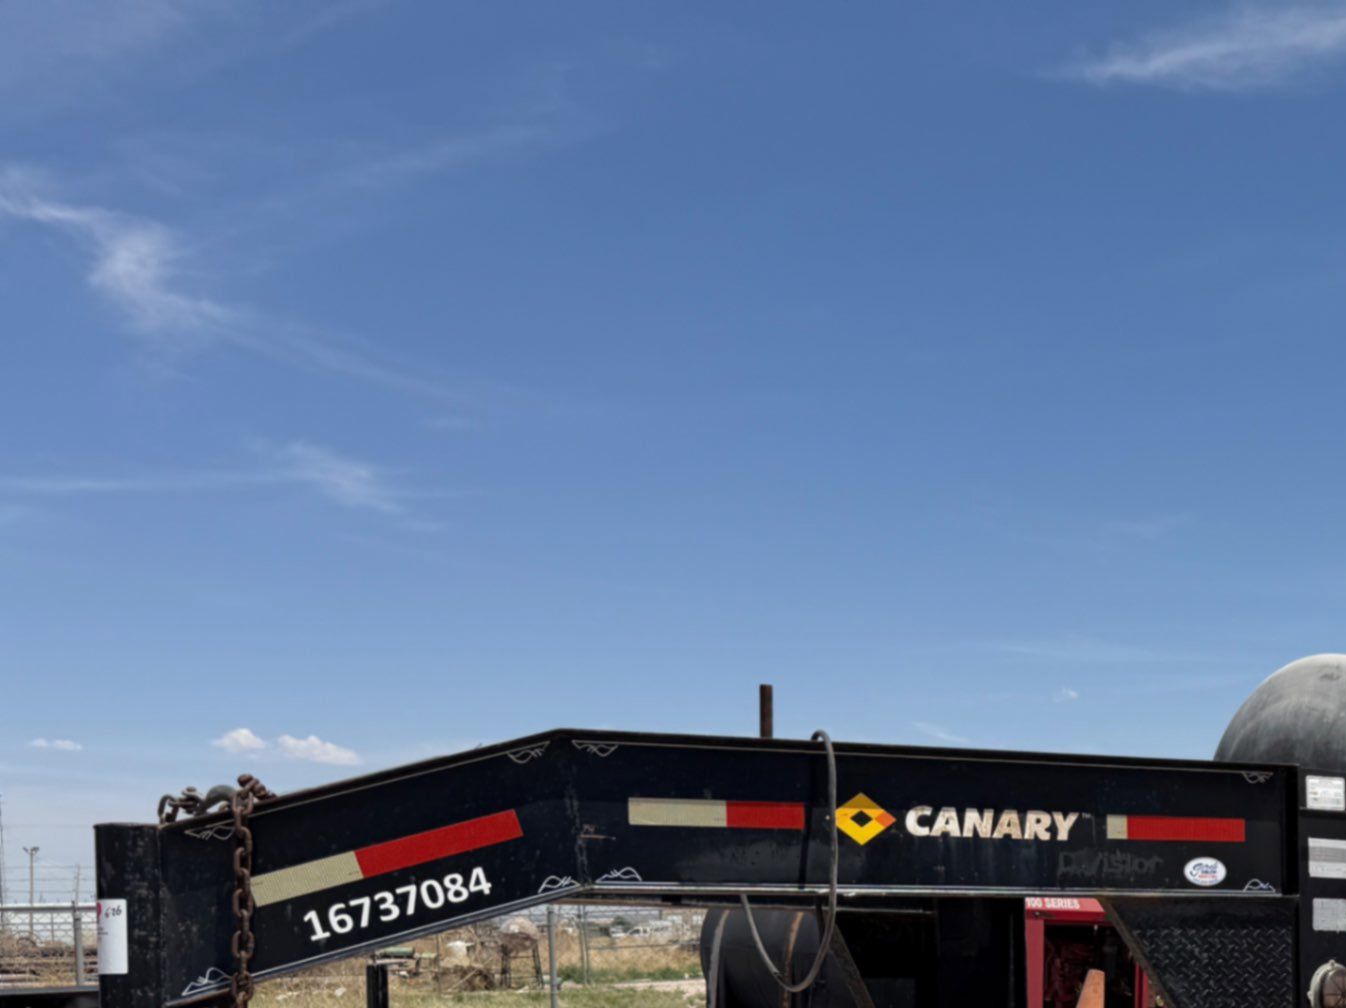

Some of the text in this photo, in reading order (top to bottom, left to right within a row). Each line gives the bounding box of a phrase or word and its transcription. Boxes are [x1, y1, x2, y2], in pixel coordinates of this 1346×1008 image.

[905, 805, 1079, 841] CANARY
[303, 866, 492, 941] 16737084
[1044, 897, 1081, 910] SERIES
